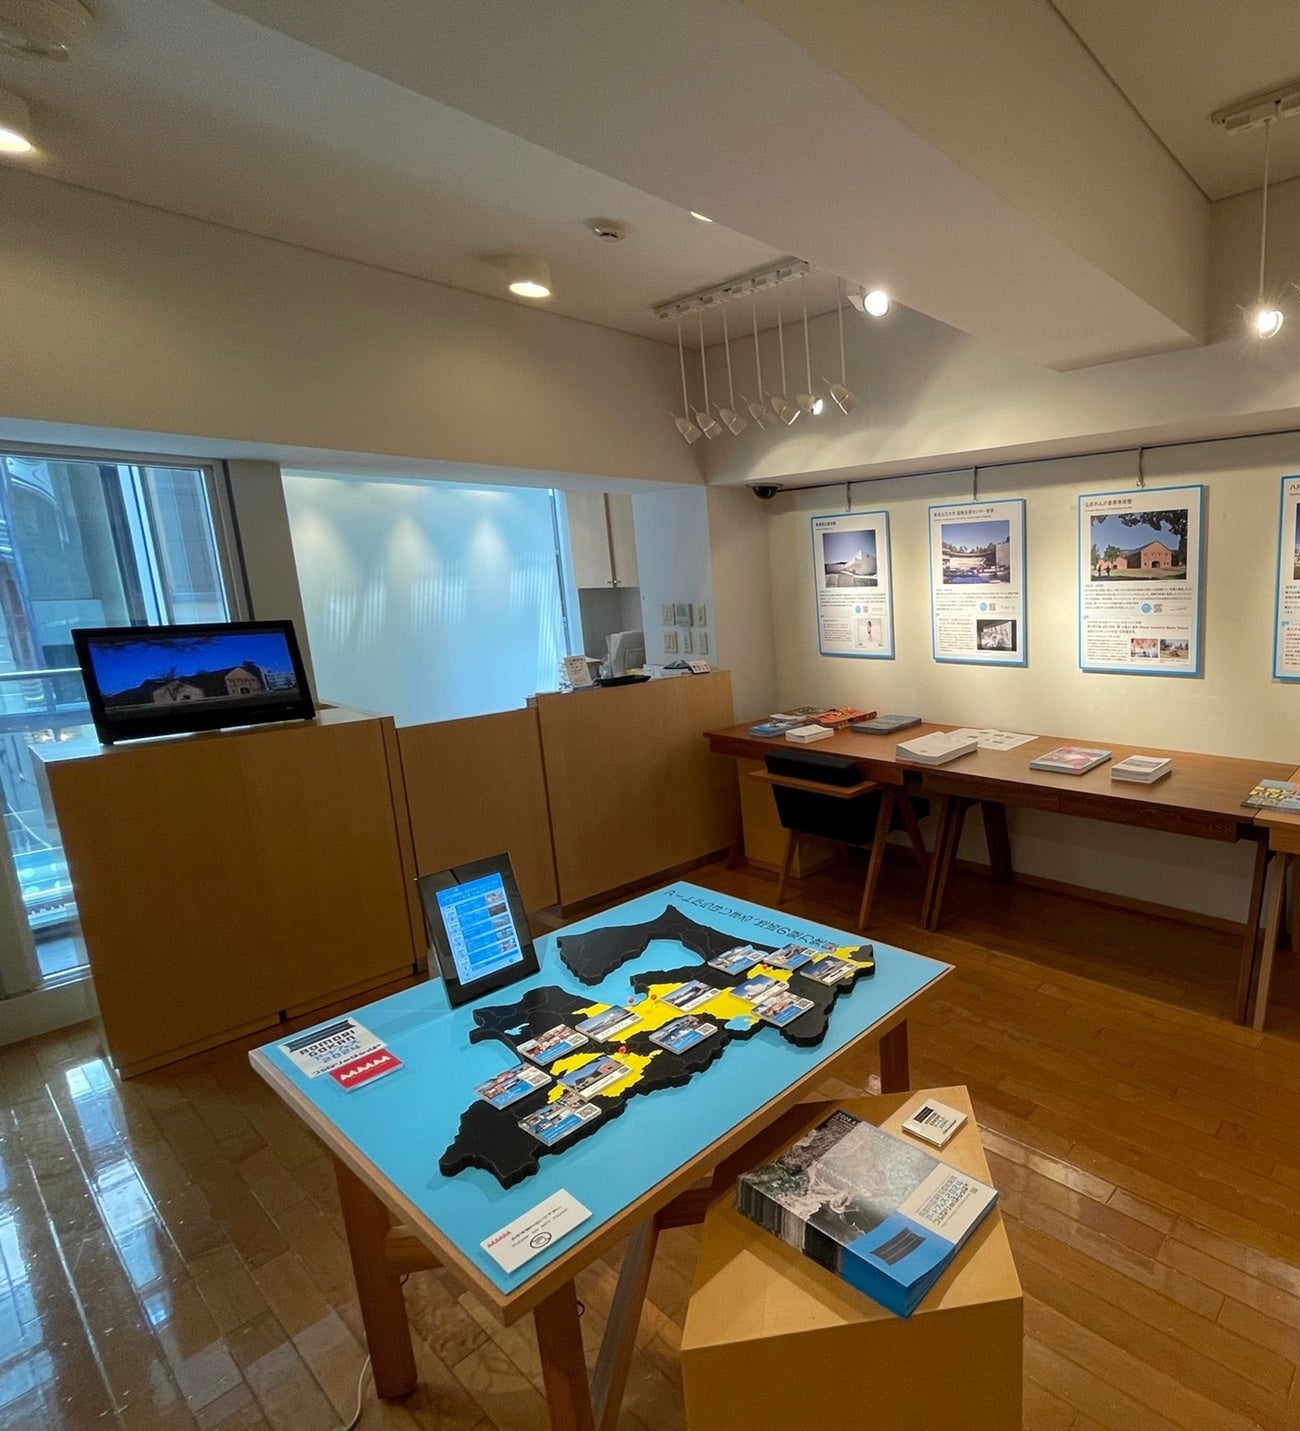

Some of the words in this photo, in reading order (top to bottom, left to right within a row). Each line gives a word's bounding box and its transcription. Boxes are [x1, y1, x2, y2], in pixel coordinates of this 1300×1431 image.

[300, 1029, 355, 1055] AOMORI
[308, 1035, 356, 1058] GOKAN
[323, 1043, 361, 1063] 2024
